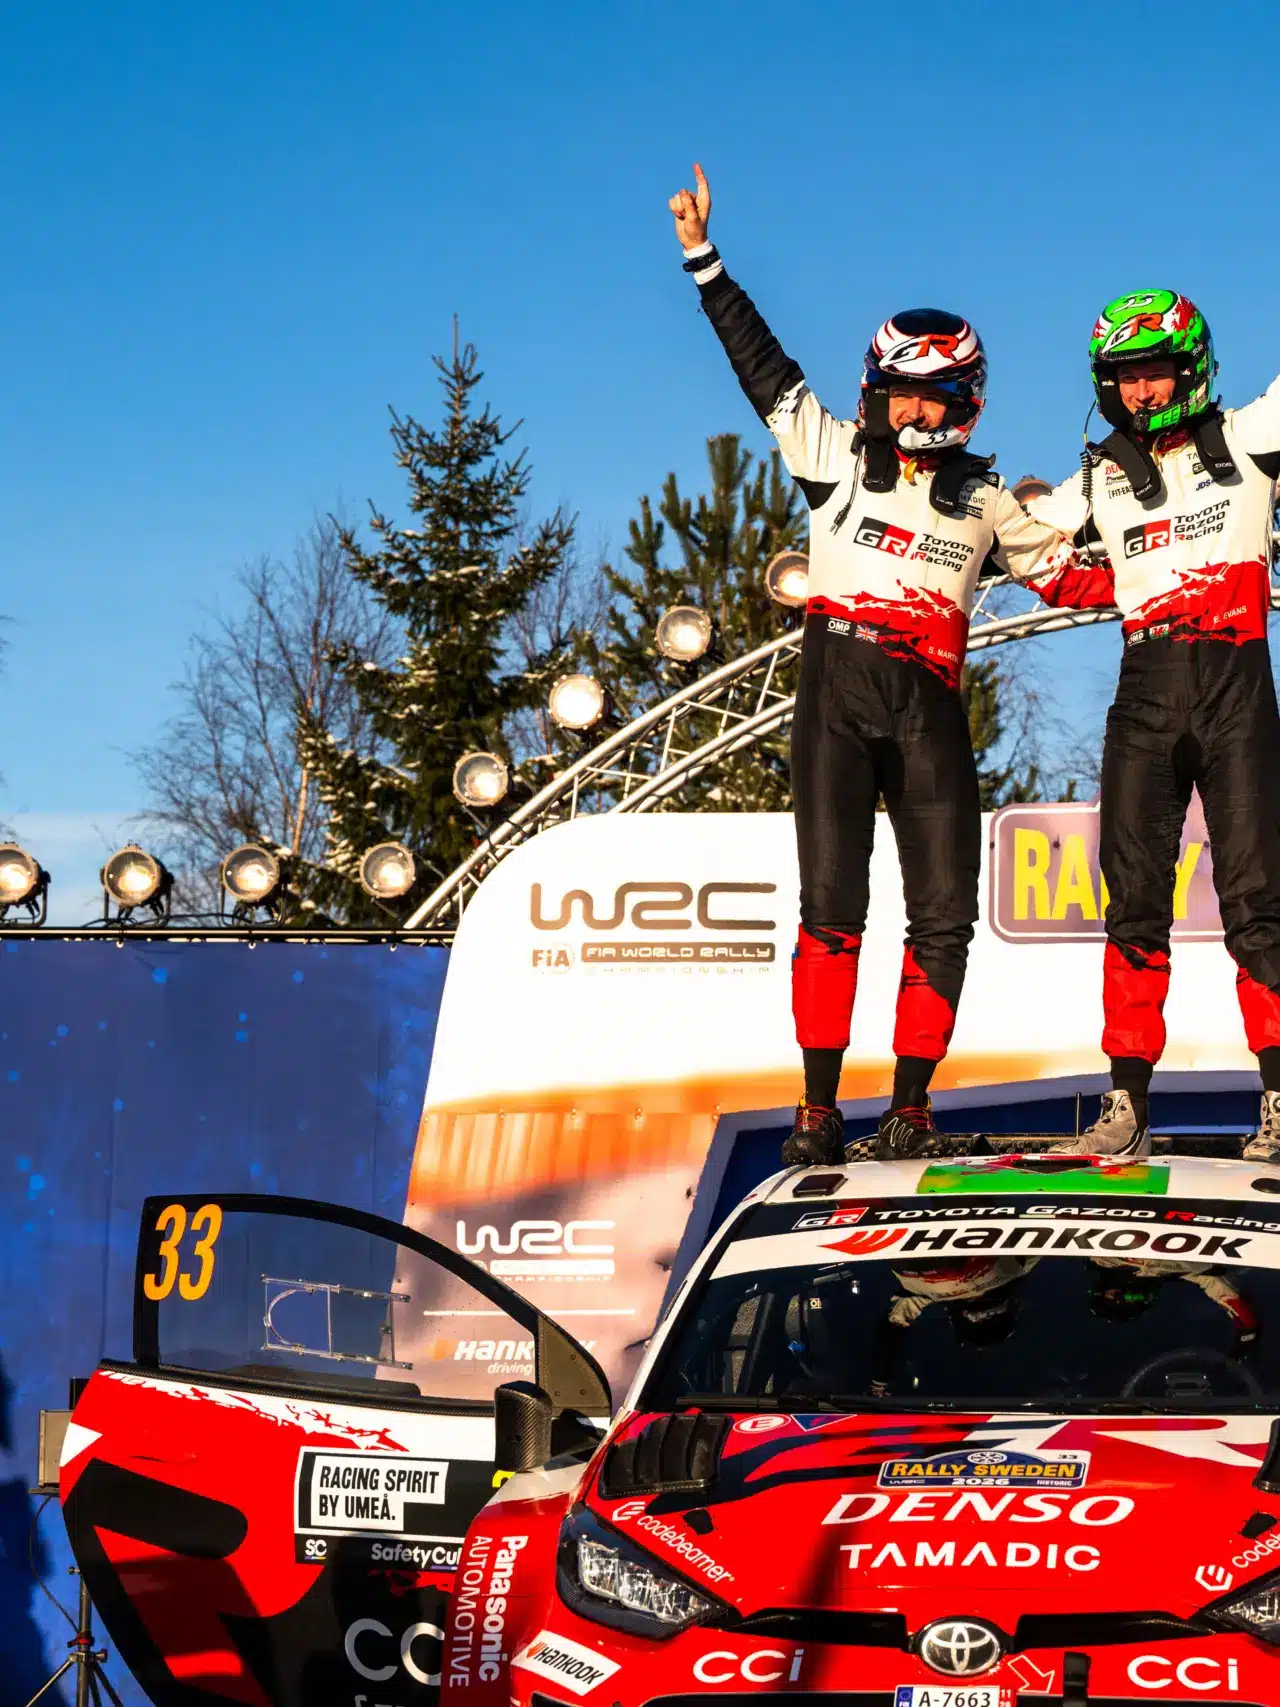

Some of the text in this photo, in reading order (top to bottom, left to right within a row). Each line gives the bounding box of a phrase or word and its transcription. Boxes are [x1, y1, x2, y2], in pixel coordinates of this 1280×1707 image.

[1174, 499, 1230, 524] TOYOTA
[1174, 511, 1226, 533] GAZOO
[856, 528, 908, 557] GR
[922, 533, 974, 554] TOYOTA
[1174, 522, 1224, 543] Racing
[917, 542, 967, 562] GAZOO
[1125, 531, 1170, 557] GR
[911, 551, 962, 572] Racing
[1223, 606, 1247, 620] EVANS
[828, 620, 850, 633] OMP
[928, 646, 936, 655] S.
[530, 882, 777, 930] WRC
[587, 947, 770, 958] FIA WORLD RALLY
[798, 1213, 861, 1229] GR
[874, 1207, 1016, 1220] TOYOTA
[1026, 1205, 1157, 1218] GAZOO
[456, 1220, 616, 1255] WRC
[143, 1204, 223, 1300] 33
[488, 1363, 533, 1376] driving
[320, 1465, 439, 1494] RACING SPIRIT
[891, 1464, 1076, 1477] RALLY SWEDEN
[951, 1478, 1010, 1486] 2026
[1036, 1479, 1073, 1487] HISTORIC
[319, 1493, 396, 1521] BY UMEÅ.
[820, 1493, 1135, 1526] DENSO
[305, 1538, 328, 1556] SC
[839, 1542, 1100, 1571] TAMADIC
[450, 1535, 493, 1688] AUTOMOTIVE
[478, 1535, 529, 1682] Panasonic
[344, 1618, 445, 1686] CC
[918, 1690, 992, 1707] A-7663
